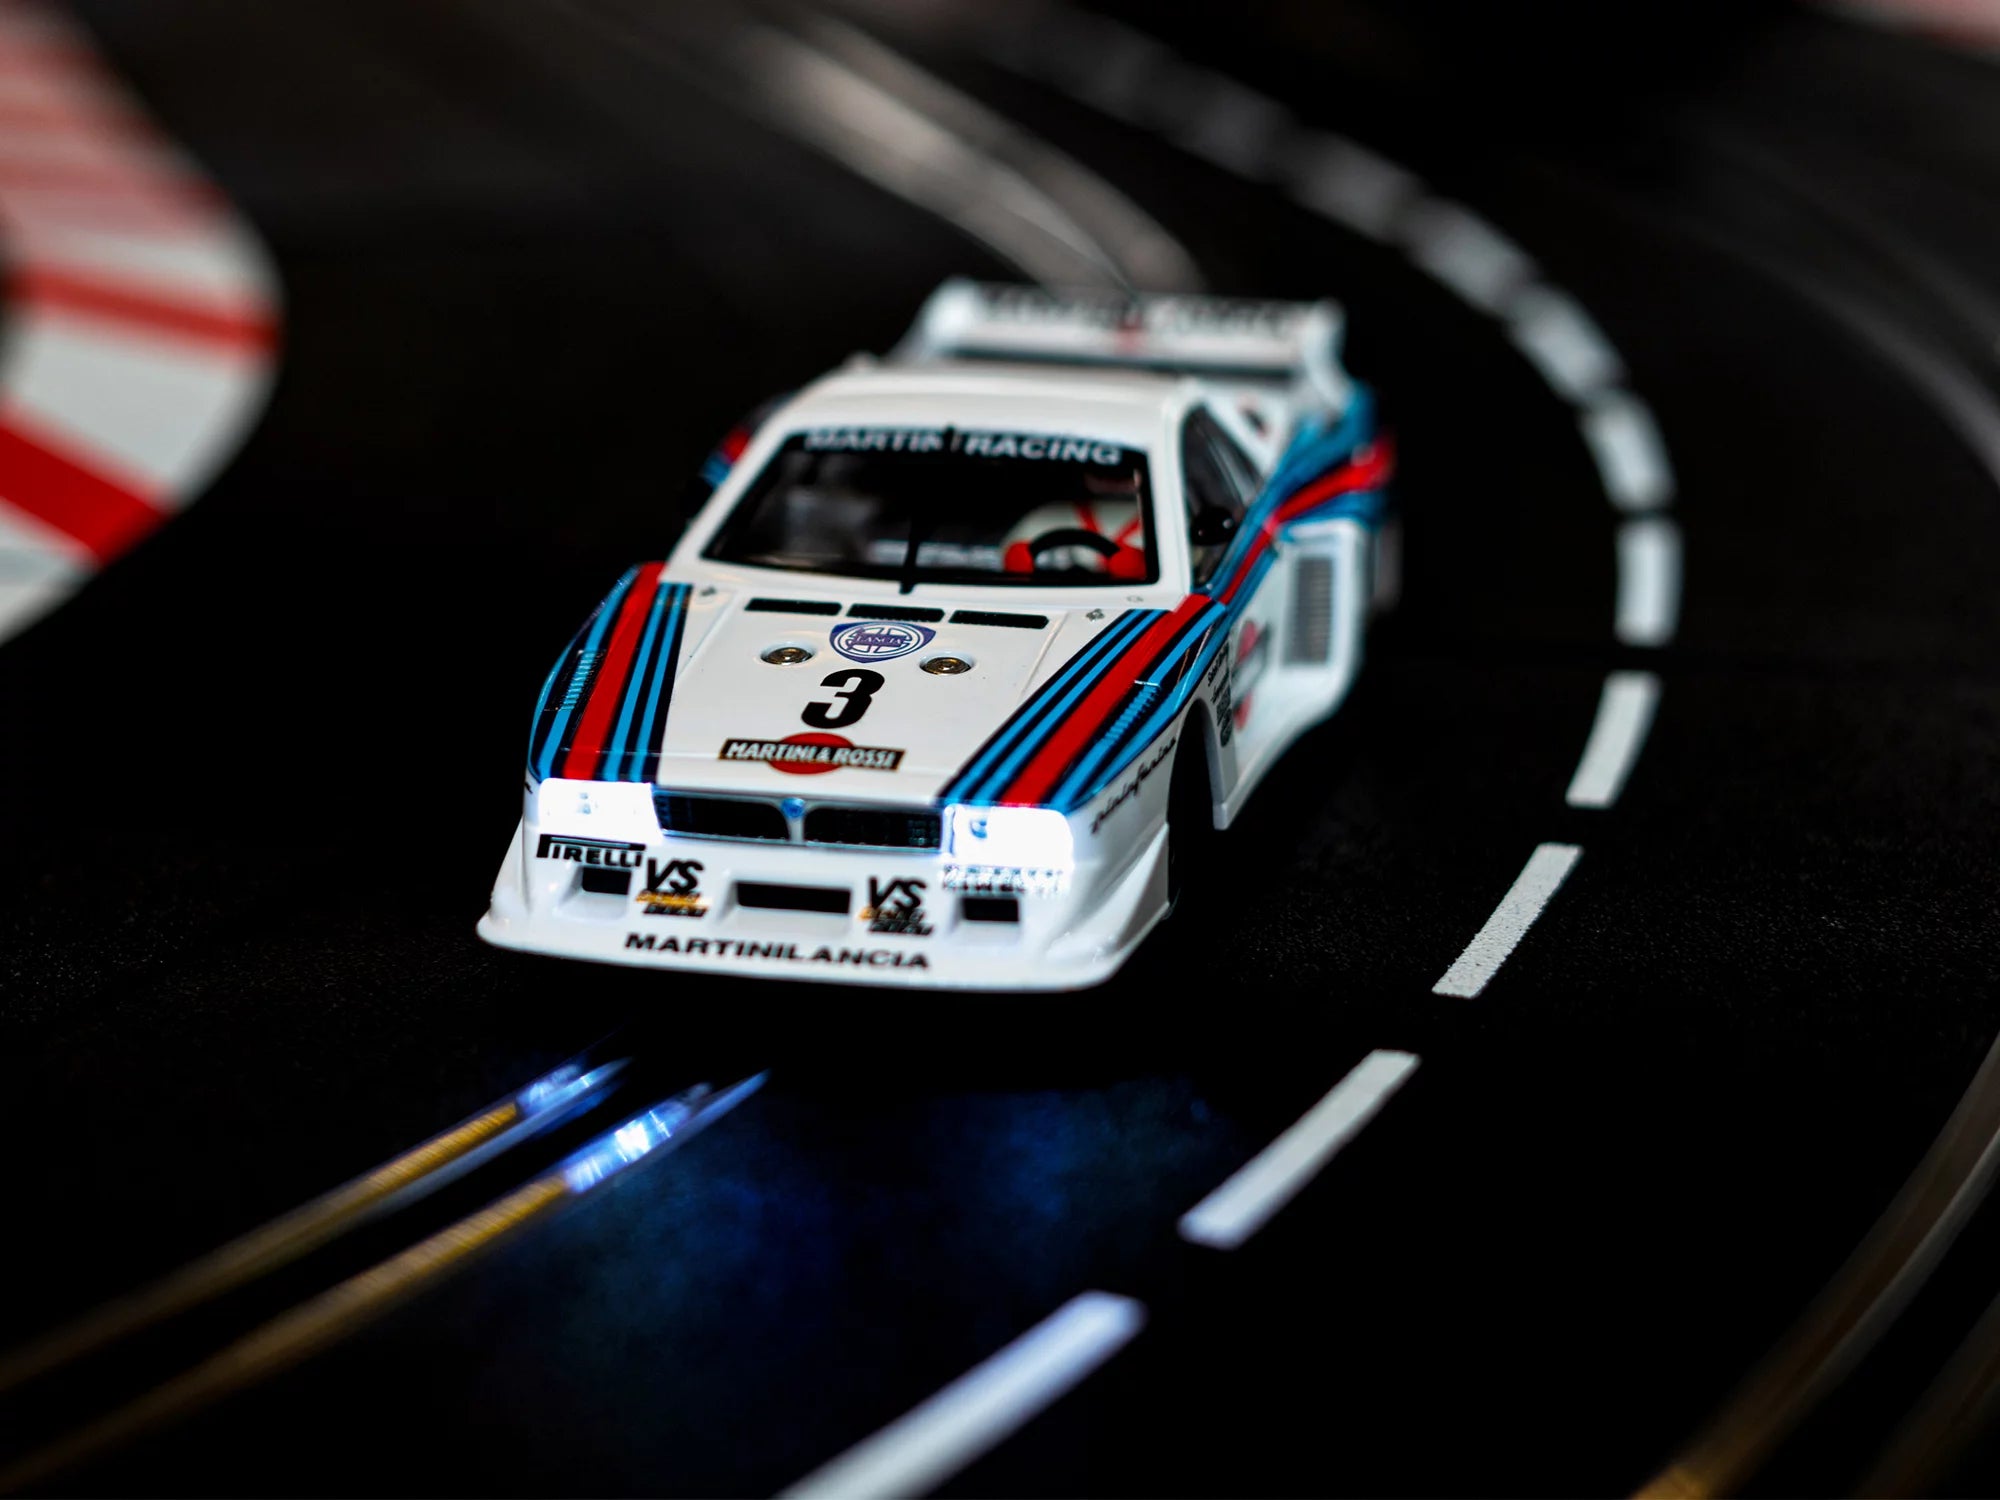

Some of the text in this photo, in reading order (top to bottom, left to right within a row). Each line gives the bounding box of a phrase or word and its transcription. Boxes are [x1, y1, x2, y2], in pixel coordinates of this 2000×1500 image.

[963, 432, 1121, 465] RACING
[801, 668, 886, 729] 3
[726, 742, 817, 761] MARTINI
[831, 748, 897, 768] ROSSI
[536, 833, 646, 868] PIRELLI
[646, 857, 704, 893] VS
[868, 876, 926, 909] VS
